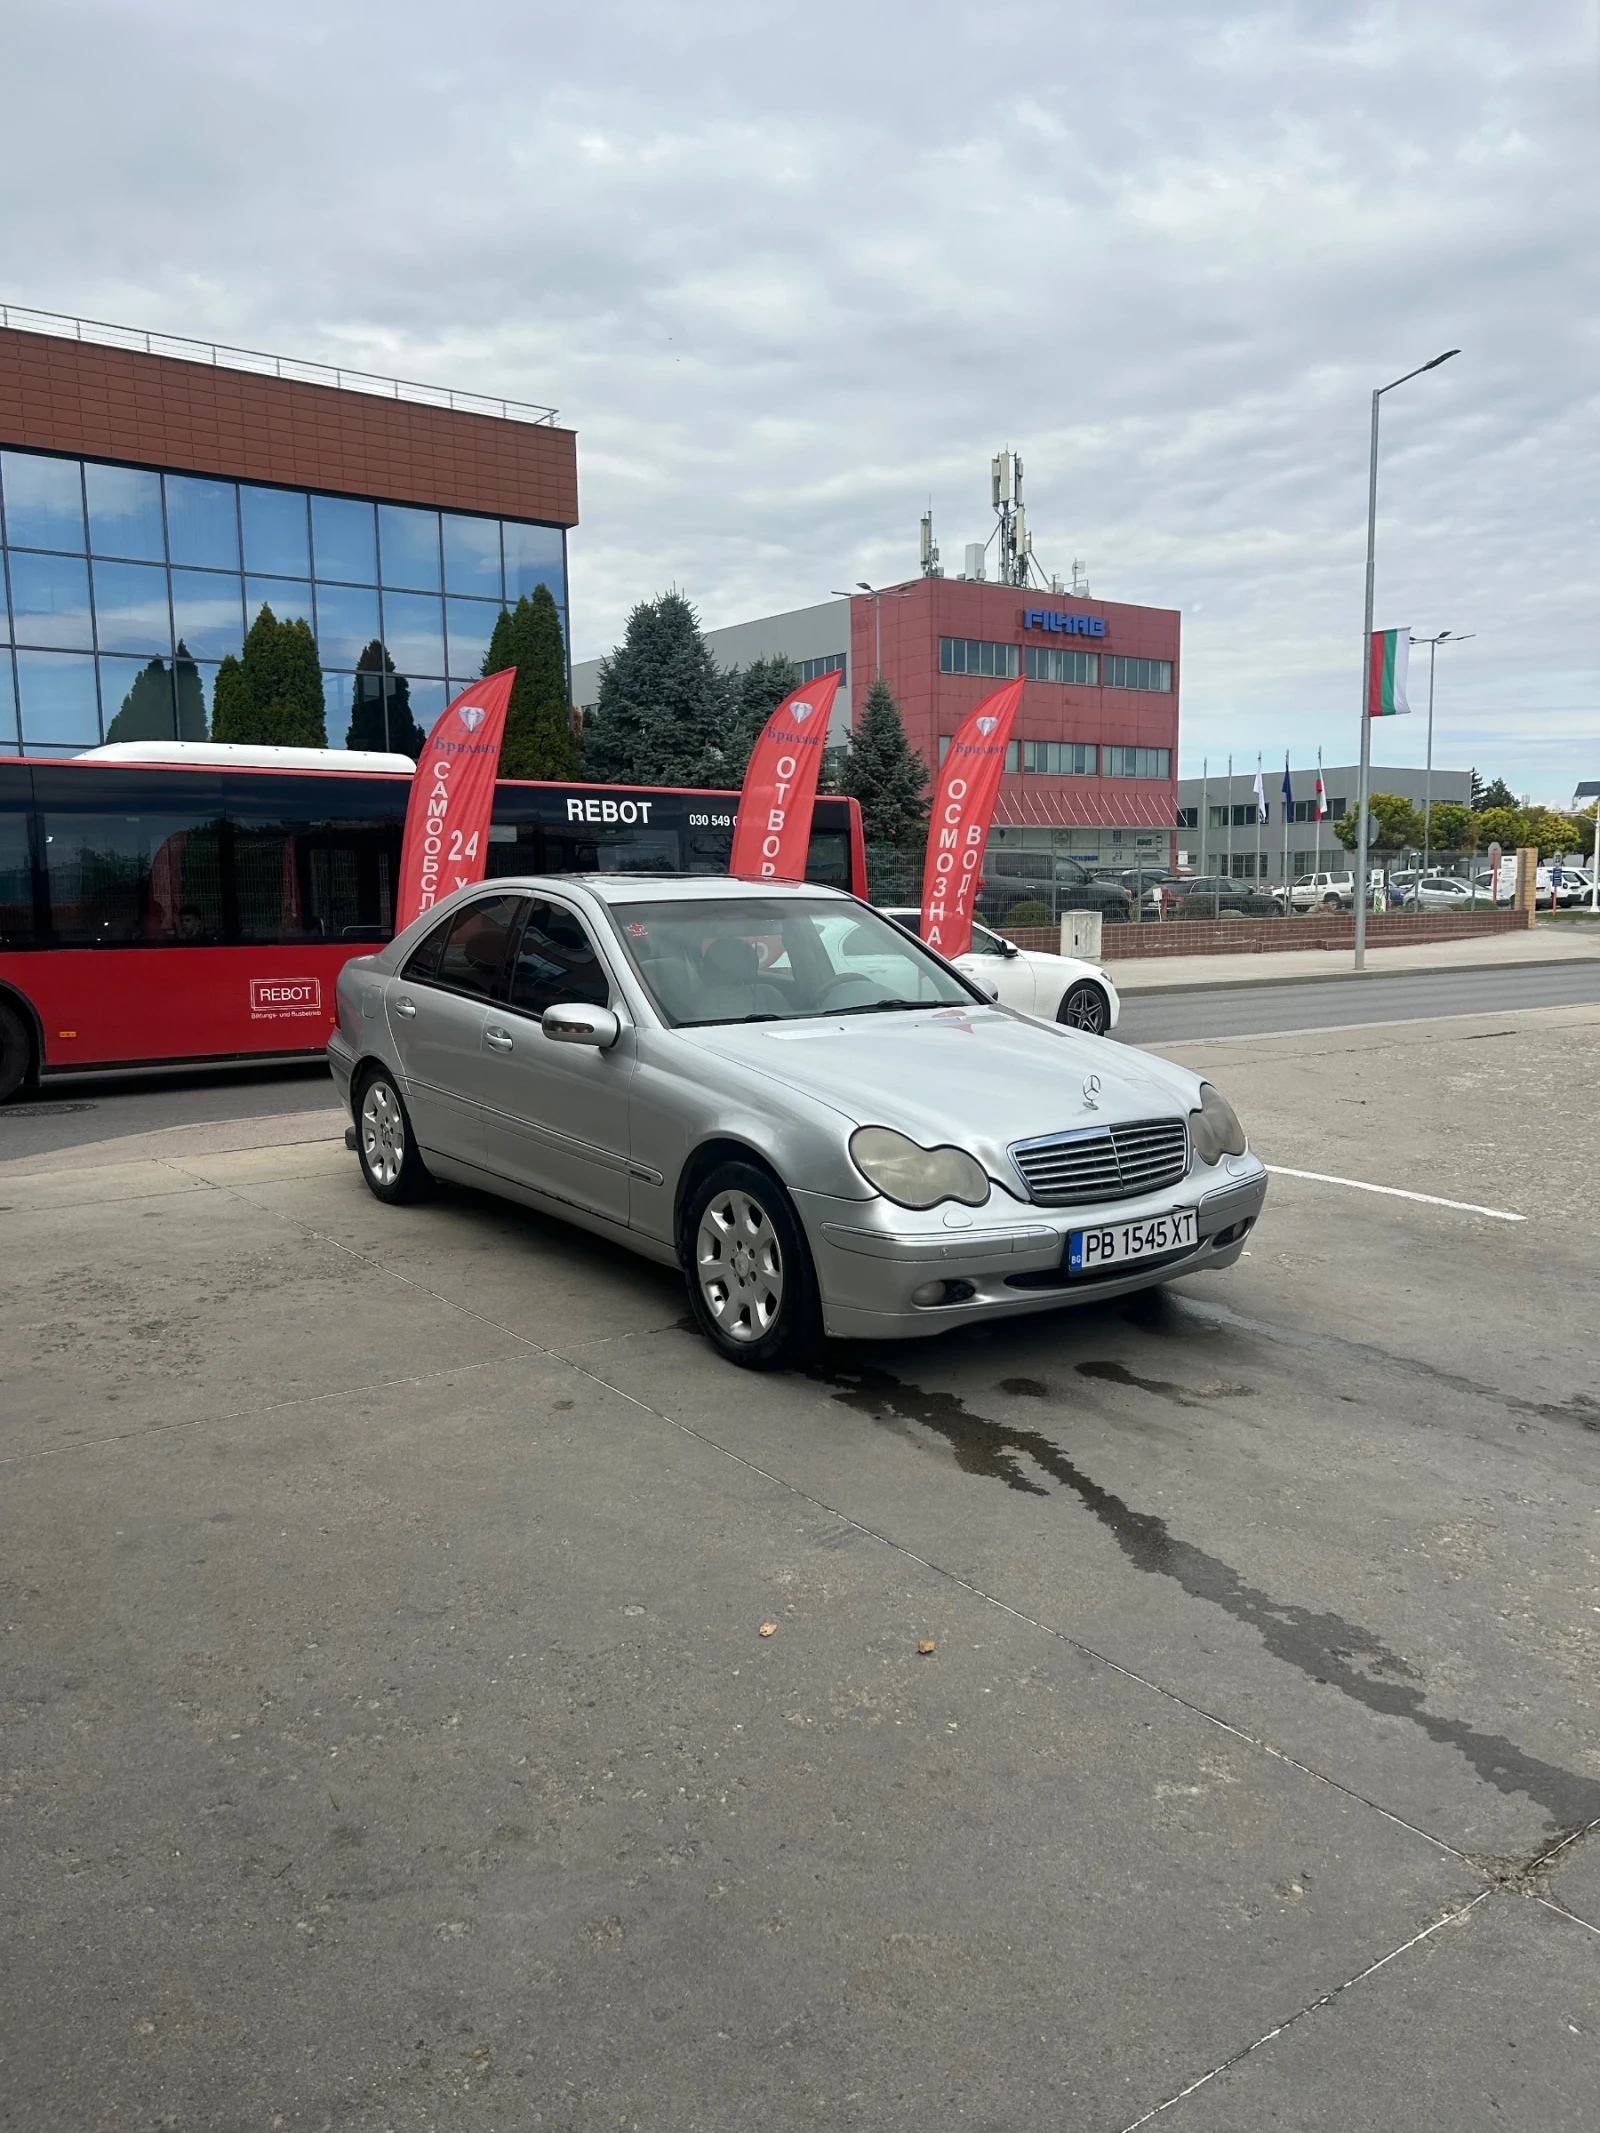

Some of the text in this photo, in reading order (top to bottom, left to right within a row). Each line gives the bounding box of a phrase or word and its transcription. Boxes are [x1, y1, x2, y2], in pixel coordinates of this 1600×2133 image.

[1024, 608, 1105, 637] FILKAB
[566, 798, 652, 824] REBOT
[689, 814, 709, 826] 030
[711, 814, 730, 827] 549
[418, 761, 451, 914] САМООБСЛ
[448, 829, 479, 861] 24
[926, 779, 966, 945] ОСМОЗНА
[956, 825, 981, 915] ВОДА
[260, 986, 312, 1001] REBOT
[1086, 1213, 1193, 1262] PB 1545 XT
[1071, 1255, 1081, 1264] BG
